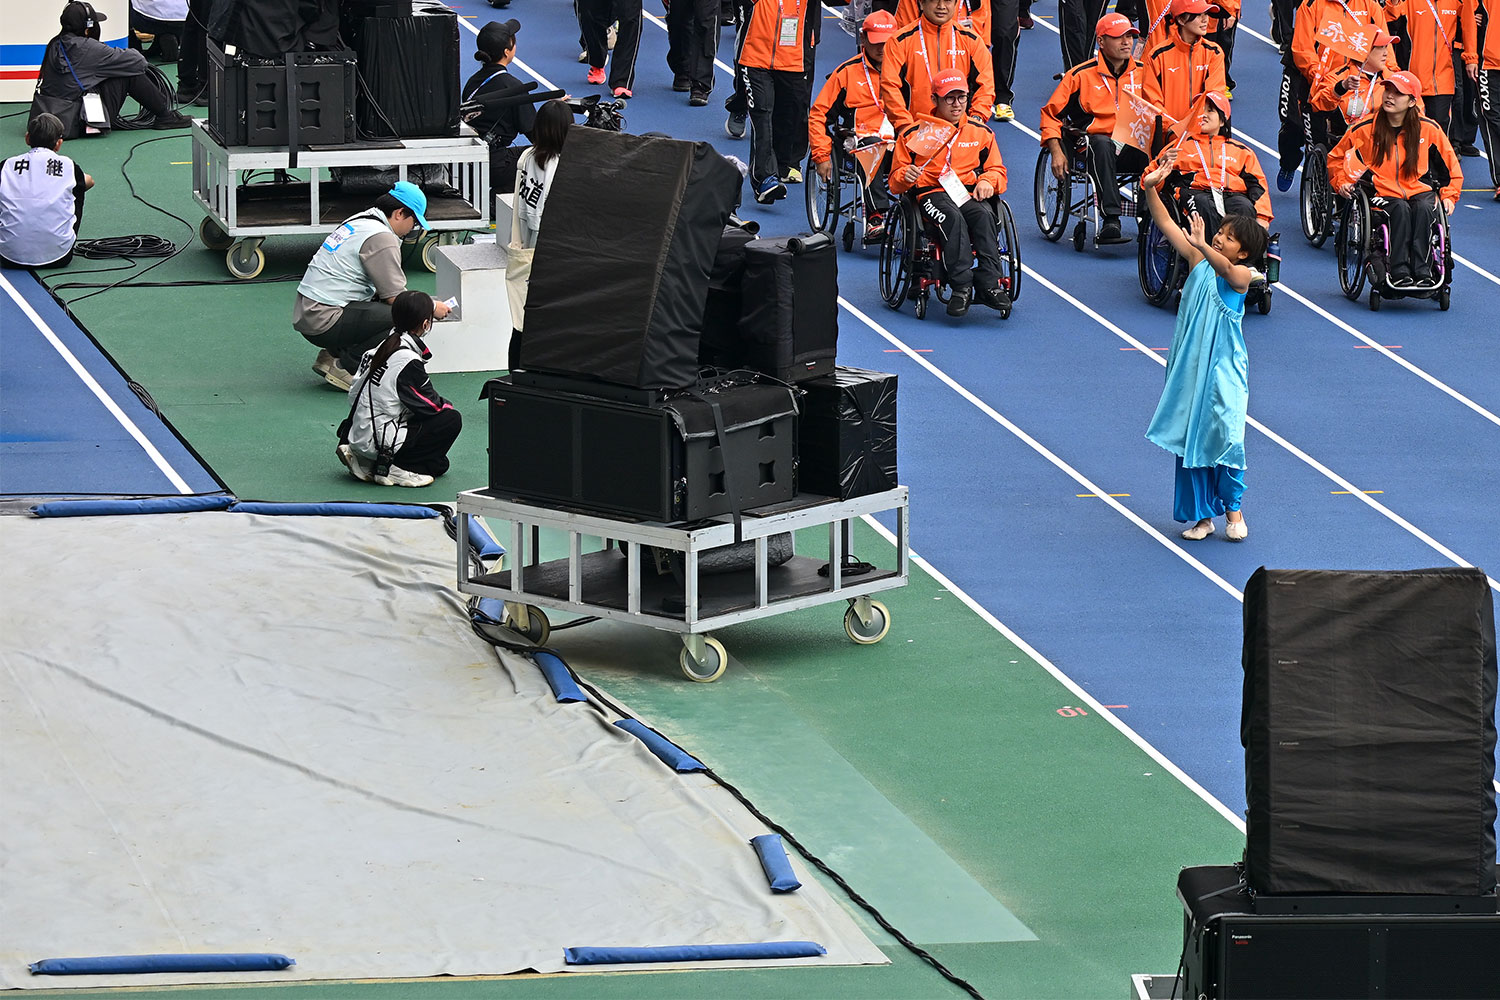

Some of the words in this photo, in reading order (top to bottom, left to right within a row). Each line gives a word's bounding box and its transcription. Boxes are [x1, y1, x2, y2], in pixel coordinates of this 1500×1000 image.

[1279, 74, 1291, 118] TOKYO
[1479, 69, 1491, 111] TOKYO
[957, 140, 979, 148] TOKYO
[14, 158, 64, 177] 中継
[923, 198, 946, 224] TOKYO
